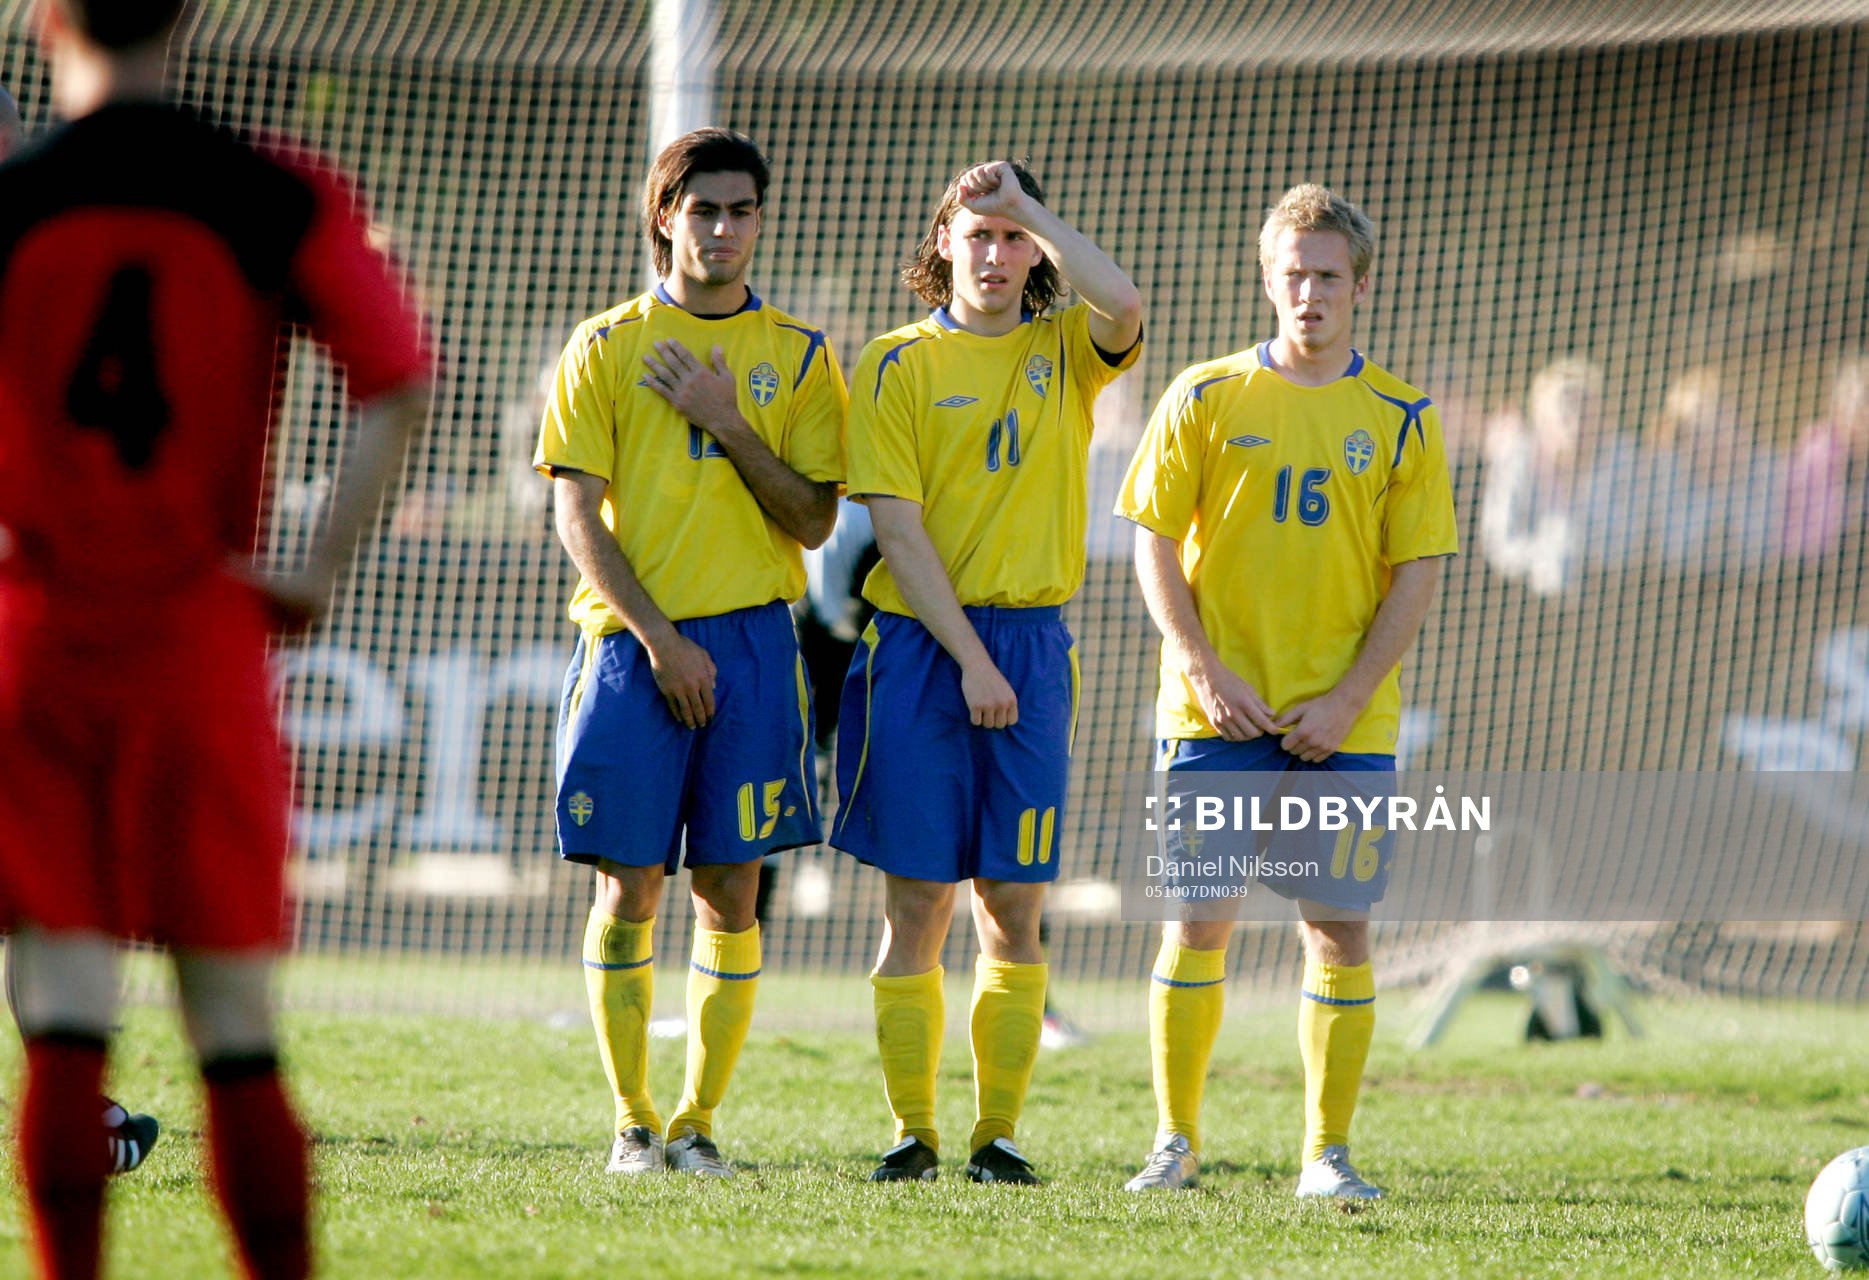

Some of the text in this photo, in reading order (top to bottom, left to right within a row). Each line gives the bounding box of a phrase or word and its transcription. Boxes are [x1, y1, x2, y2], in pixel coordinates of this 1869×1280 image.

[63, 260, 176, 475] 4
[687, 422, 728, 460] 1
[985, 407, 1020, 472] 11
[1272, 464, 1332, 526] 16
[1017, 806, 1055, 866] 11
[1330, 822, 1386, 882] 16
